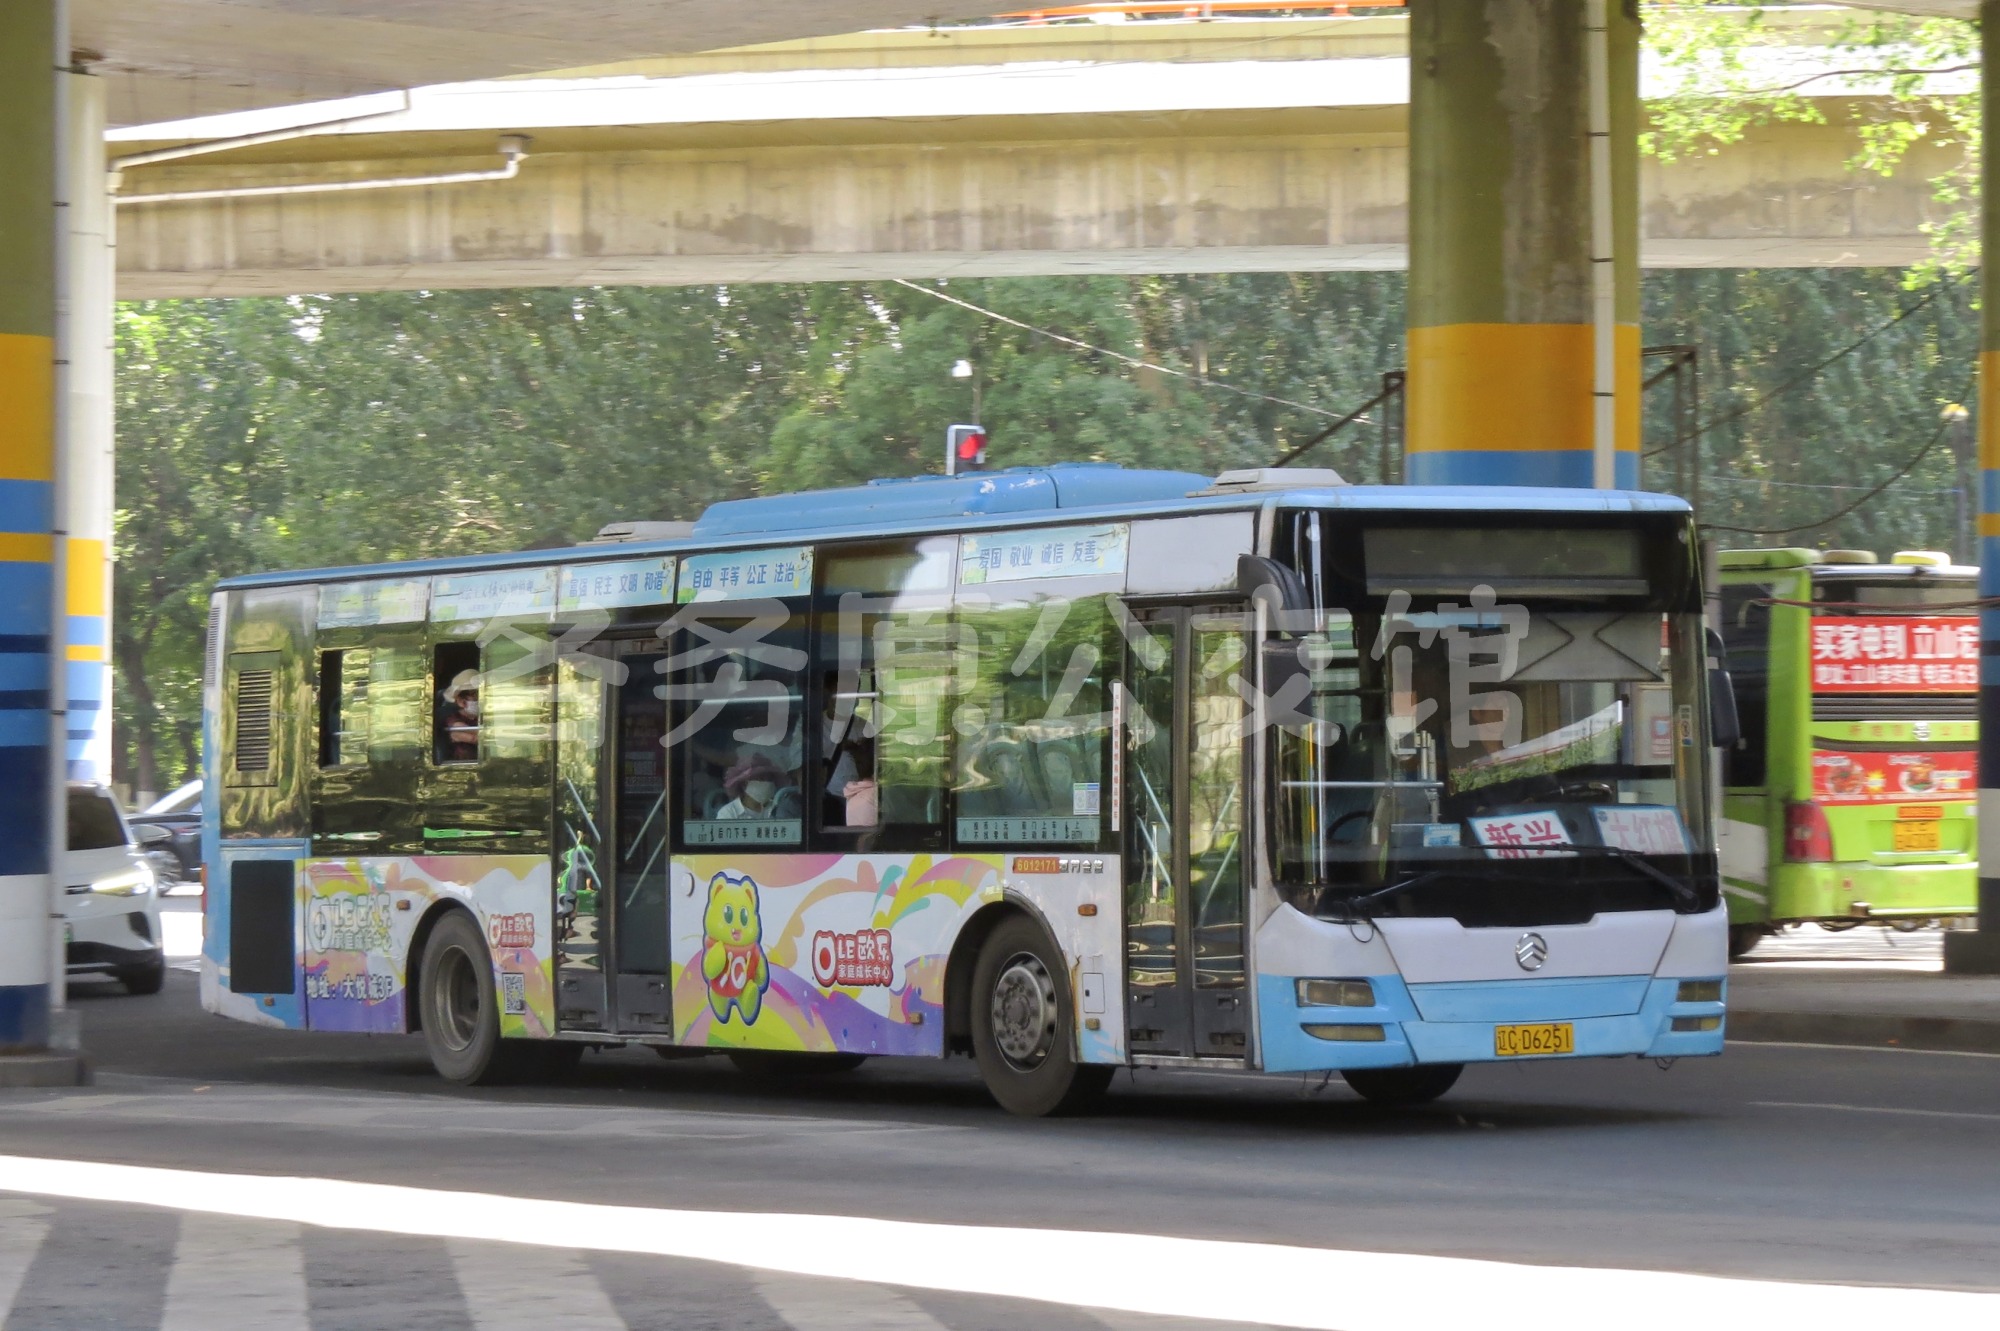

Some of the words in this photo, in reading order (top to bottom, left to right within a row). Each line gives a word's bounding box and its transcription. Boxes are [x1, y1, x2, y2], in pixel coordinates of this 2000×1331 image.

[979, 547, 1002, 569] 爱国
[1009, 545, 1033, 567] 敬业
[1041, 543, 1064, 564] 诚信
[1072, 540, 1097, 562] 友善
[569, 578, 588, 598] 富强
[594, 576, 612, 596] 民主
[618, 573, 638, 594] 文明
[644, 571, 666, 591] 和谐
[693, 568, 713, 588] 自由
[720, 566, 740, 587] 平等
[747, 564, 768, 584] 公正
[774, 561, 795, 583] 法治
[718, 827, 748, 839] 后门下车
[1484, 819, 1564, 859] 新兴
[1016, 859, 1057, 872] 6012171
[858, 934, 889, 961] 欧乐
[838, 964, 890, 980] 家庭成长中心
